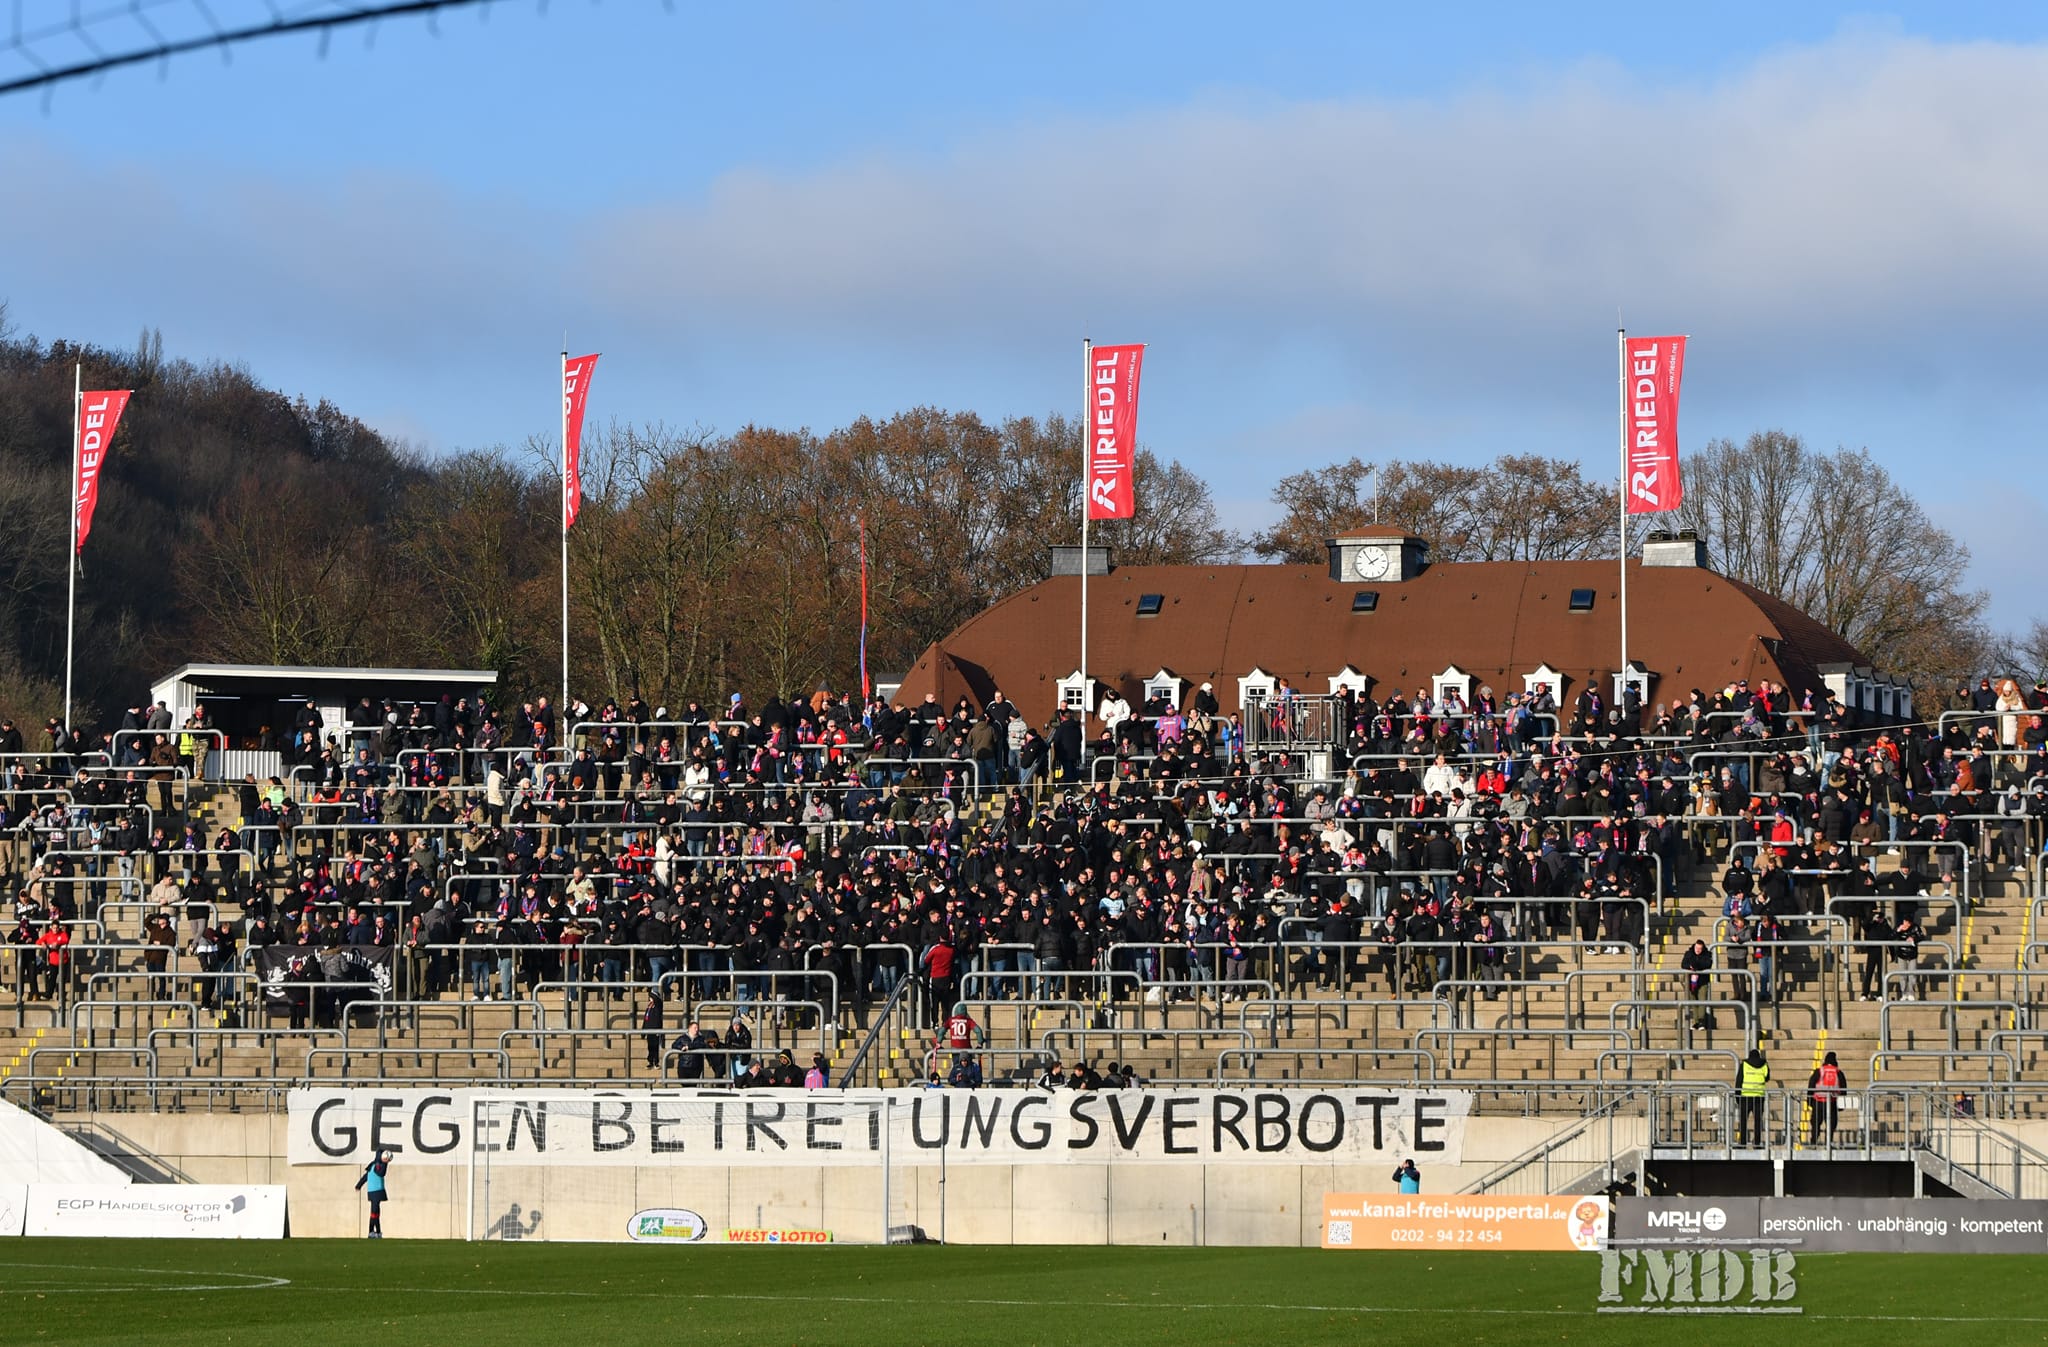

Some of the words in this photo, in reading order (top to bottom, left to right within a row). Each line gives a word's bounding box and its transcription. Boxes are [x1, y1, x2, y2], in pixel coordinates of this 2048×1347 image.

[1096, 352, 1119, 455] RIEDEL
[1634, 343, 1658, 448] RIEDEL
[951, 1022, 967, 1036] 10
[311, 1095, 547, 1157] GEGEN
[57, 1199, 94, 1210] EGP
[1329, 1201, 1567, 1222] www.kanal-frei-wuppertal.de
[1647, 1211, 1701, 1227] MRH
[1763, 1216, 1843, 1234] persönlich
[1857, 1217, 1948, 1236] unabhängig
[1960, 1217, 2044, 1236] kompetent
[728, 1230, 768, 1242] WEST
[781, 1231, 826, 1243] LOTTO
[1391, 1229, 1424, 1242] 0202
[1437, 1229, 1453, 1242] 94
[1458, 1229, 1474, 1242] 22
[1477, 1229, 1502, 1242] 454
